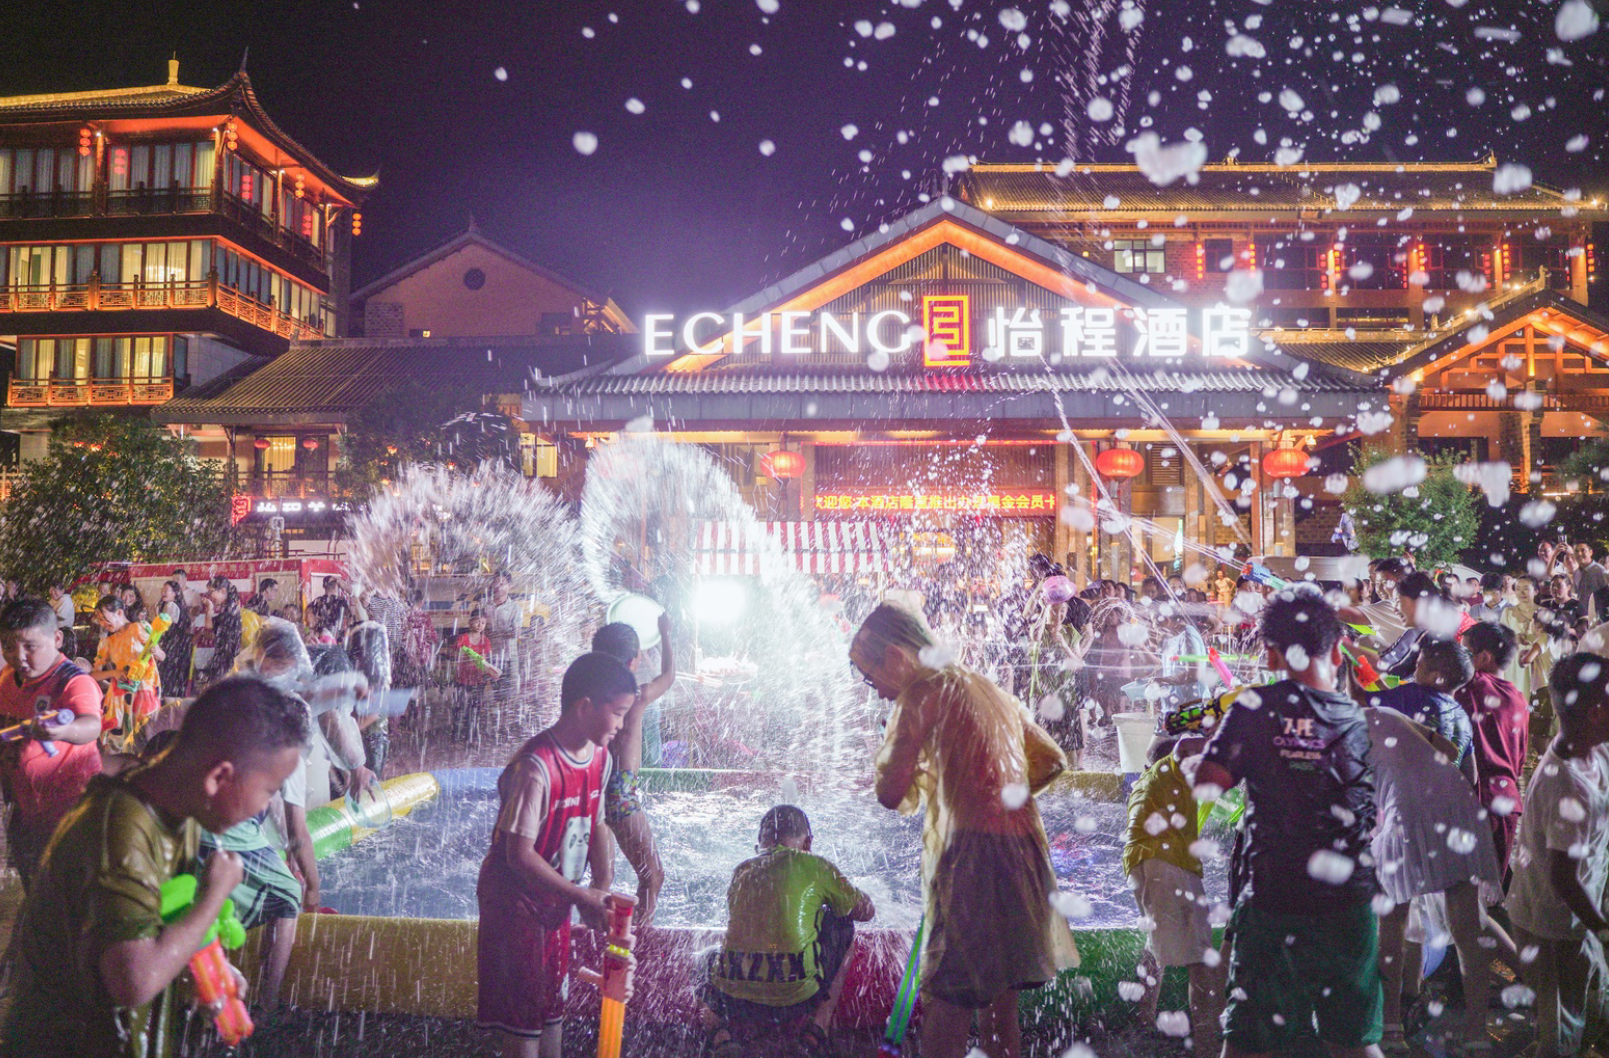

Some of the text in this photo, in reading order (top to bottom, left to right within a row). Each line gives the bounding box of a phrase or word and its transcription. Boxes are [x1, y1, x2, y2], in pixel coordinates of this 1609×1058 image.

[644, 311, 912, 356] ECHENG
[986, 304, 1253, 358] 怡程酒店
